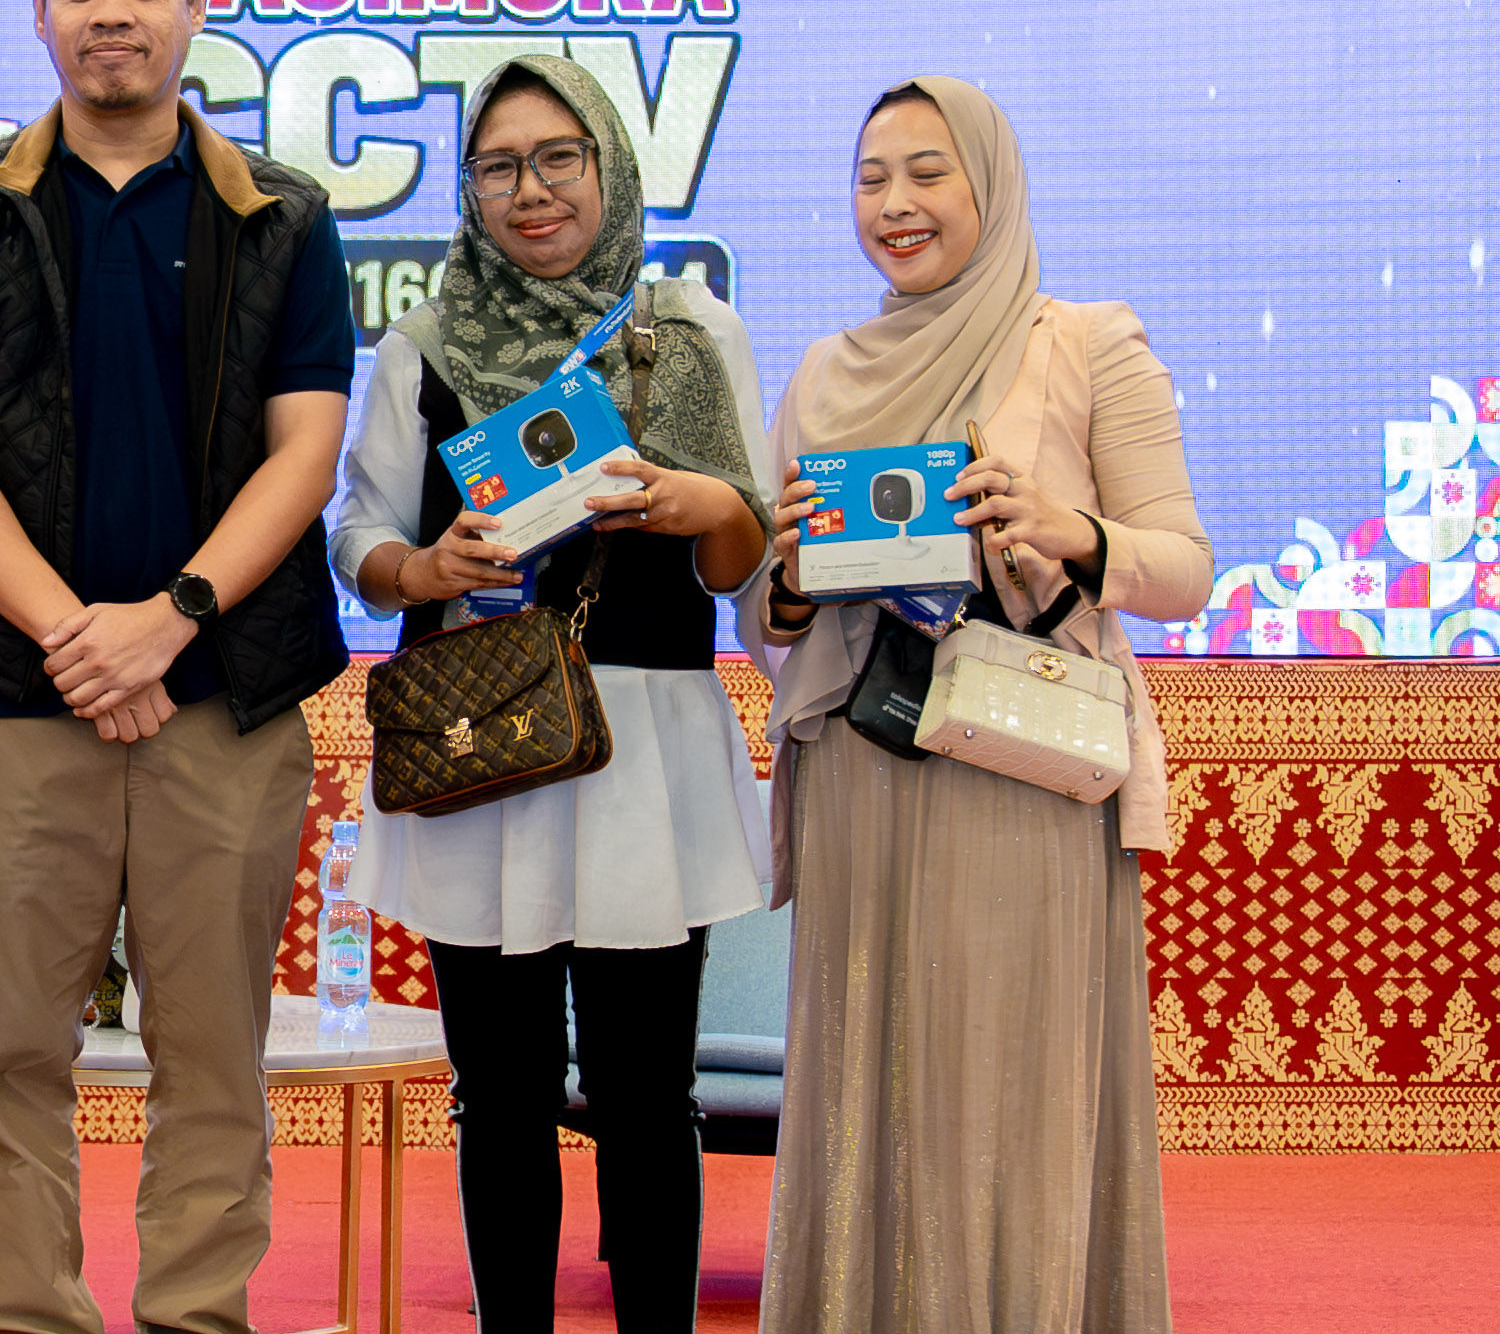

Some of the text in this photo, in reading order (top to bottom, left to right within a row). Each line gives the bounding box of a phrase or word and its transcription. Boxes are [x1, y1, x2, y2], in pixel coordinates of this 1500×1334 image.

[561, 376, 581, 395] 2K
[447, 430, 486, 456] tapo
[805, 458, 847, 475] tapo
[342, 951, 353, 960] Le
